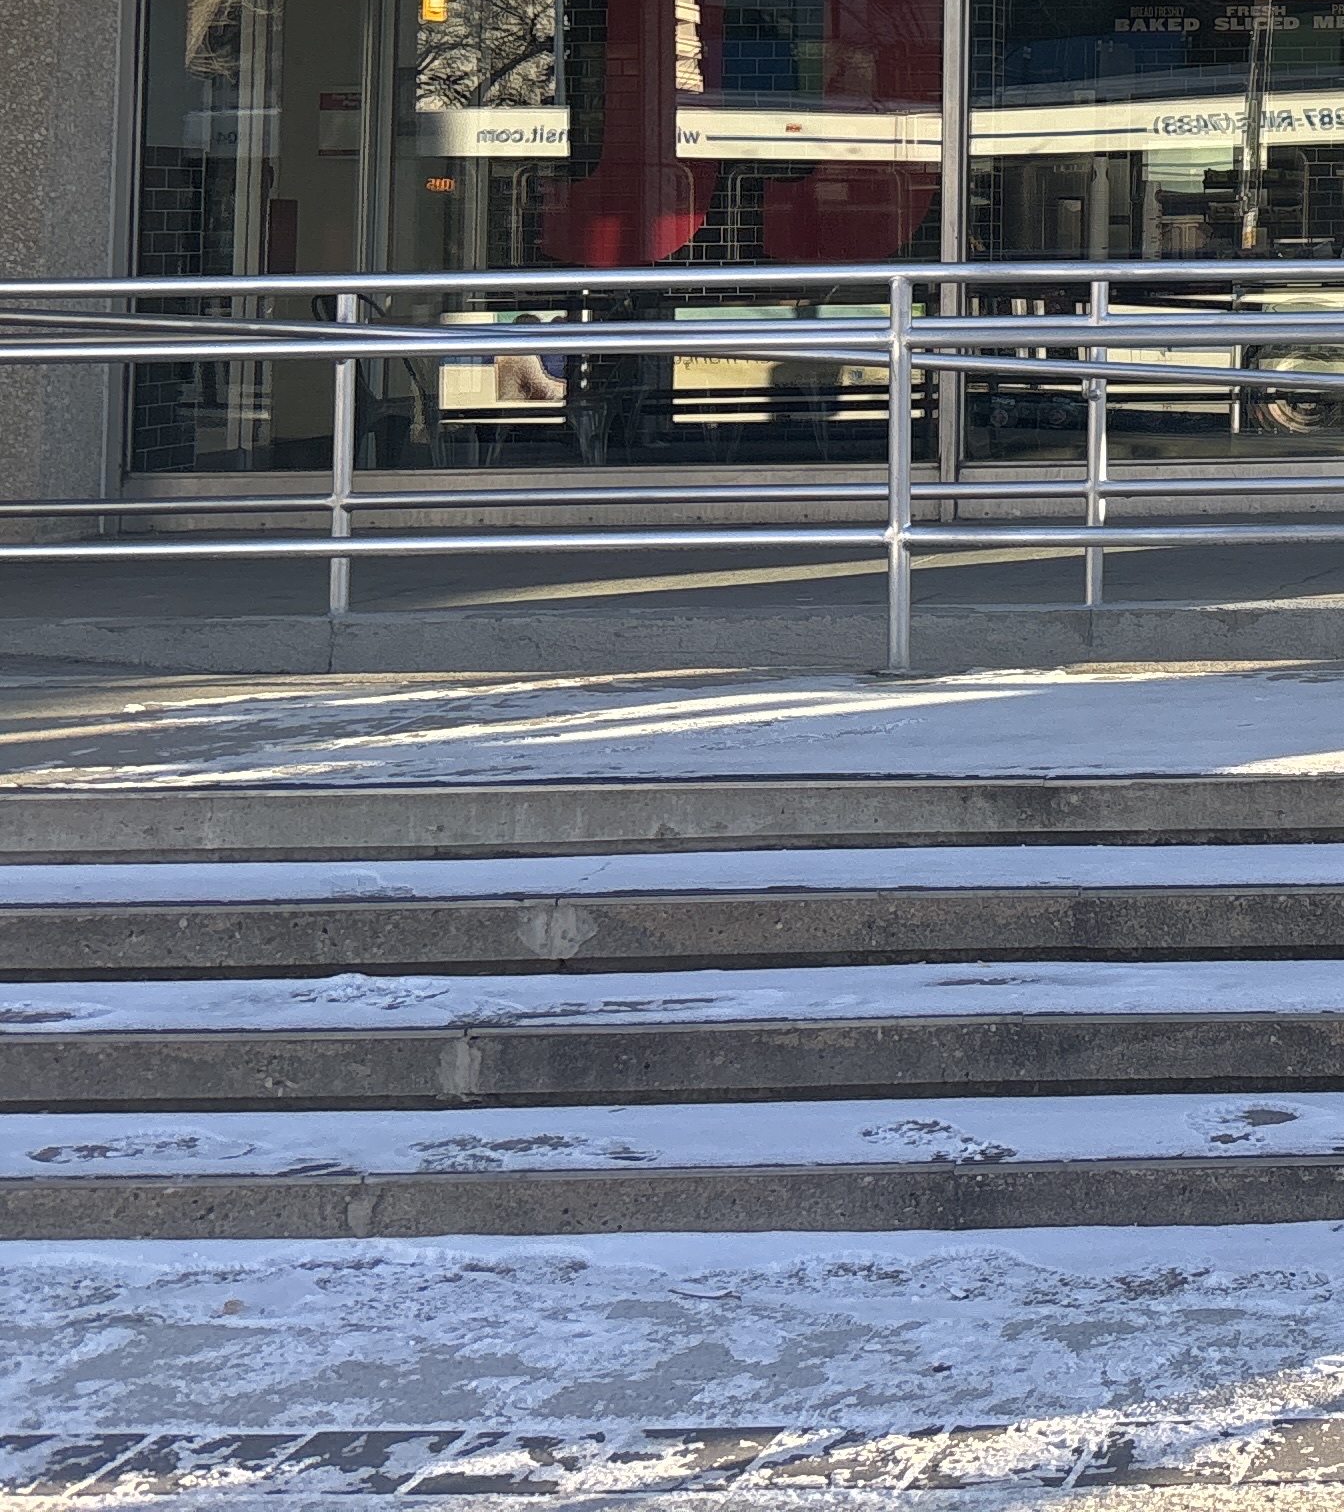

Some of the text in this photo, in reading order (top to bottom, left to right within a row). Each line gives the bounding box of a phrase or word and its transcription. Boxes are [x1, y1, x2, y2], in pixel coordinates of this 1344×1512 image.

[1226, 5, 1287, 16] FRESH
[1114, 18, 1200, 31] BAKED
[1214, 17, 1300, 30] SLICED
